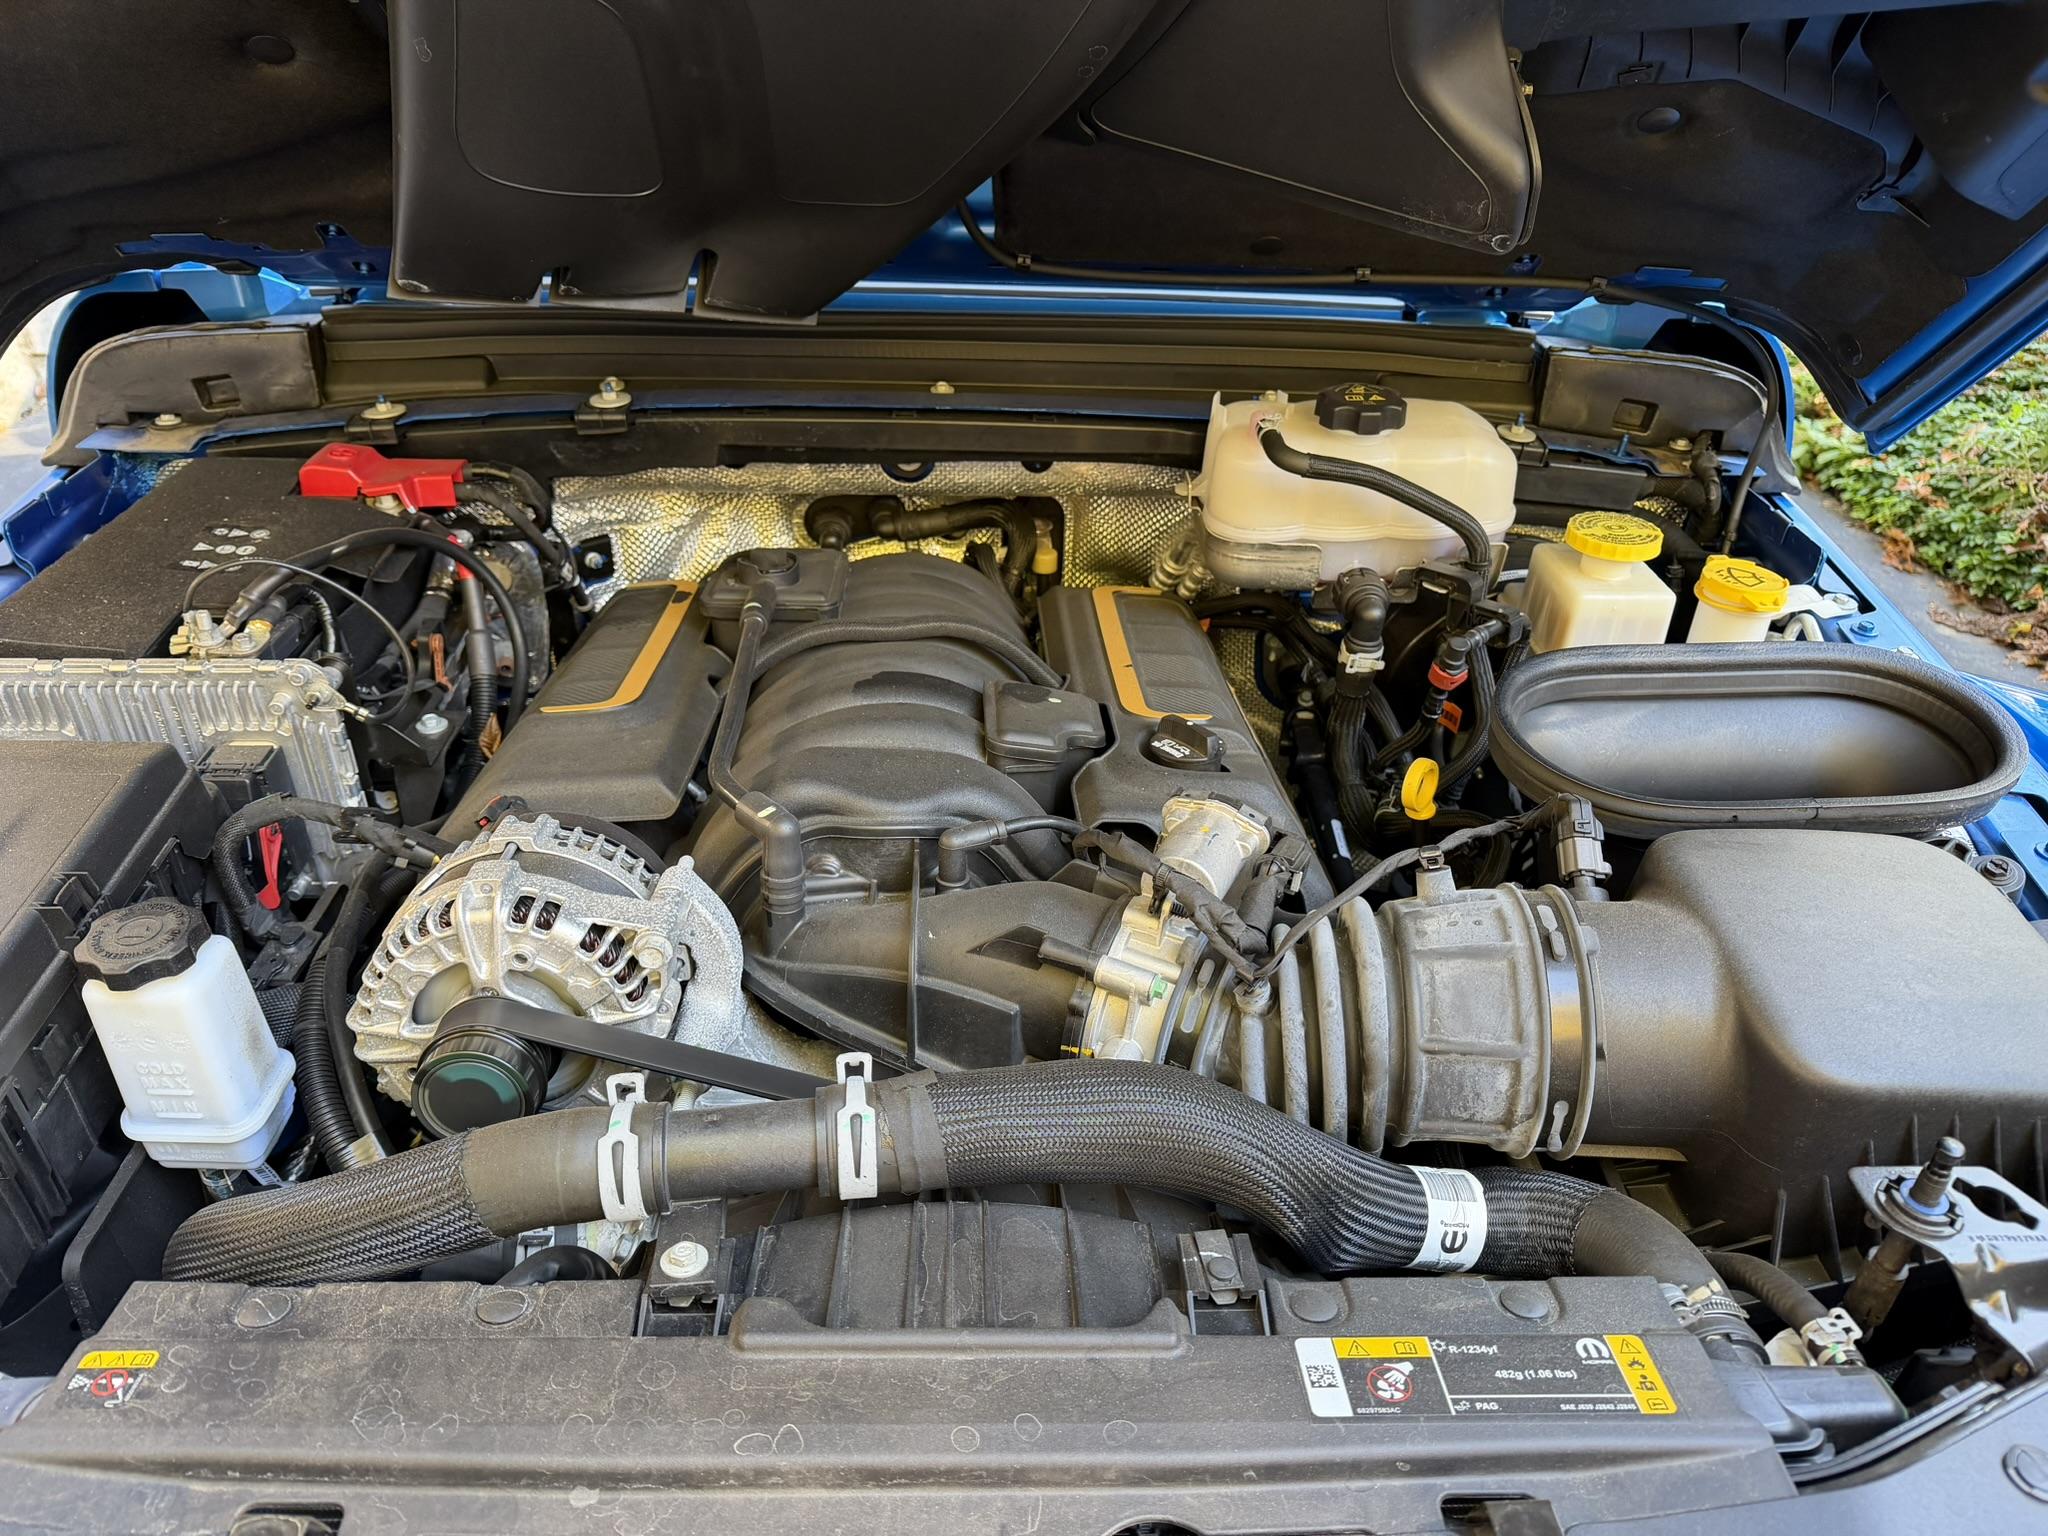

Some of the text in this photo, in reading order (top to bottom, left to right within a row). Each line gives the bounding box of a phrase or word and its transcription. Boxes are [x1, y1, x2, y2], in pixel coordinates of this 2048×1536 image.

[136, 1062, 184, 1075] COLD
[140, 1077, 192, 1089] MAX
[150, 1100, 199, 1112] MIN
[1448, 1344, 1498, 1356] R-1234yf
[1494, 1369, 1578, 1380] 482g (1.06 lbs)
[1475, 1402, 1498, 1411] PAG
